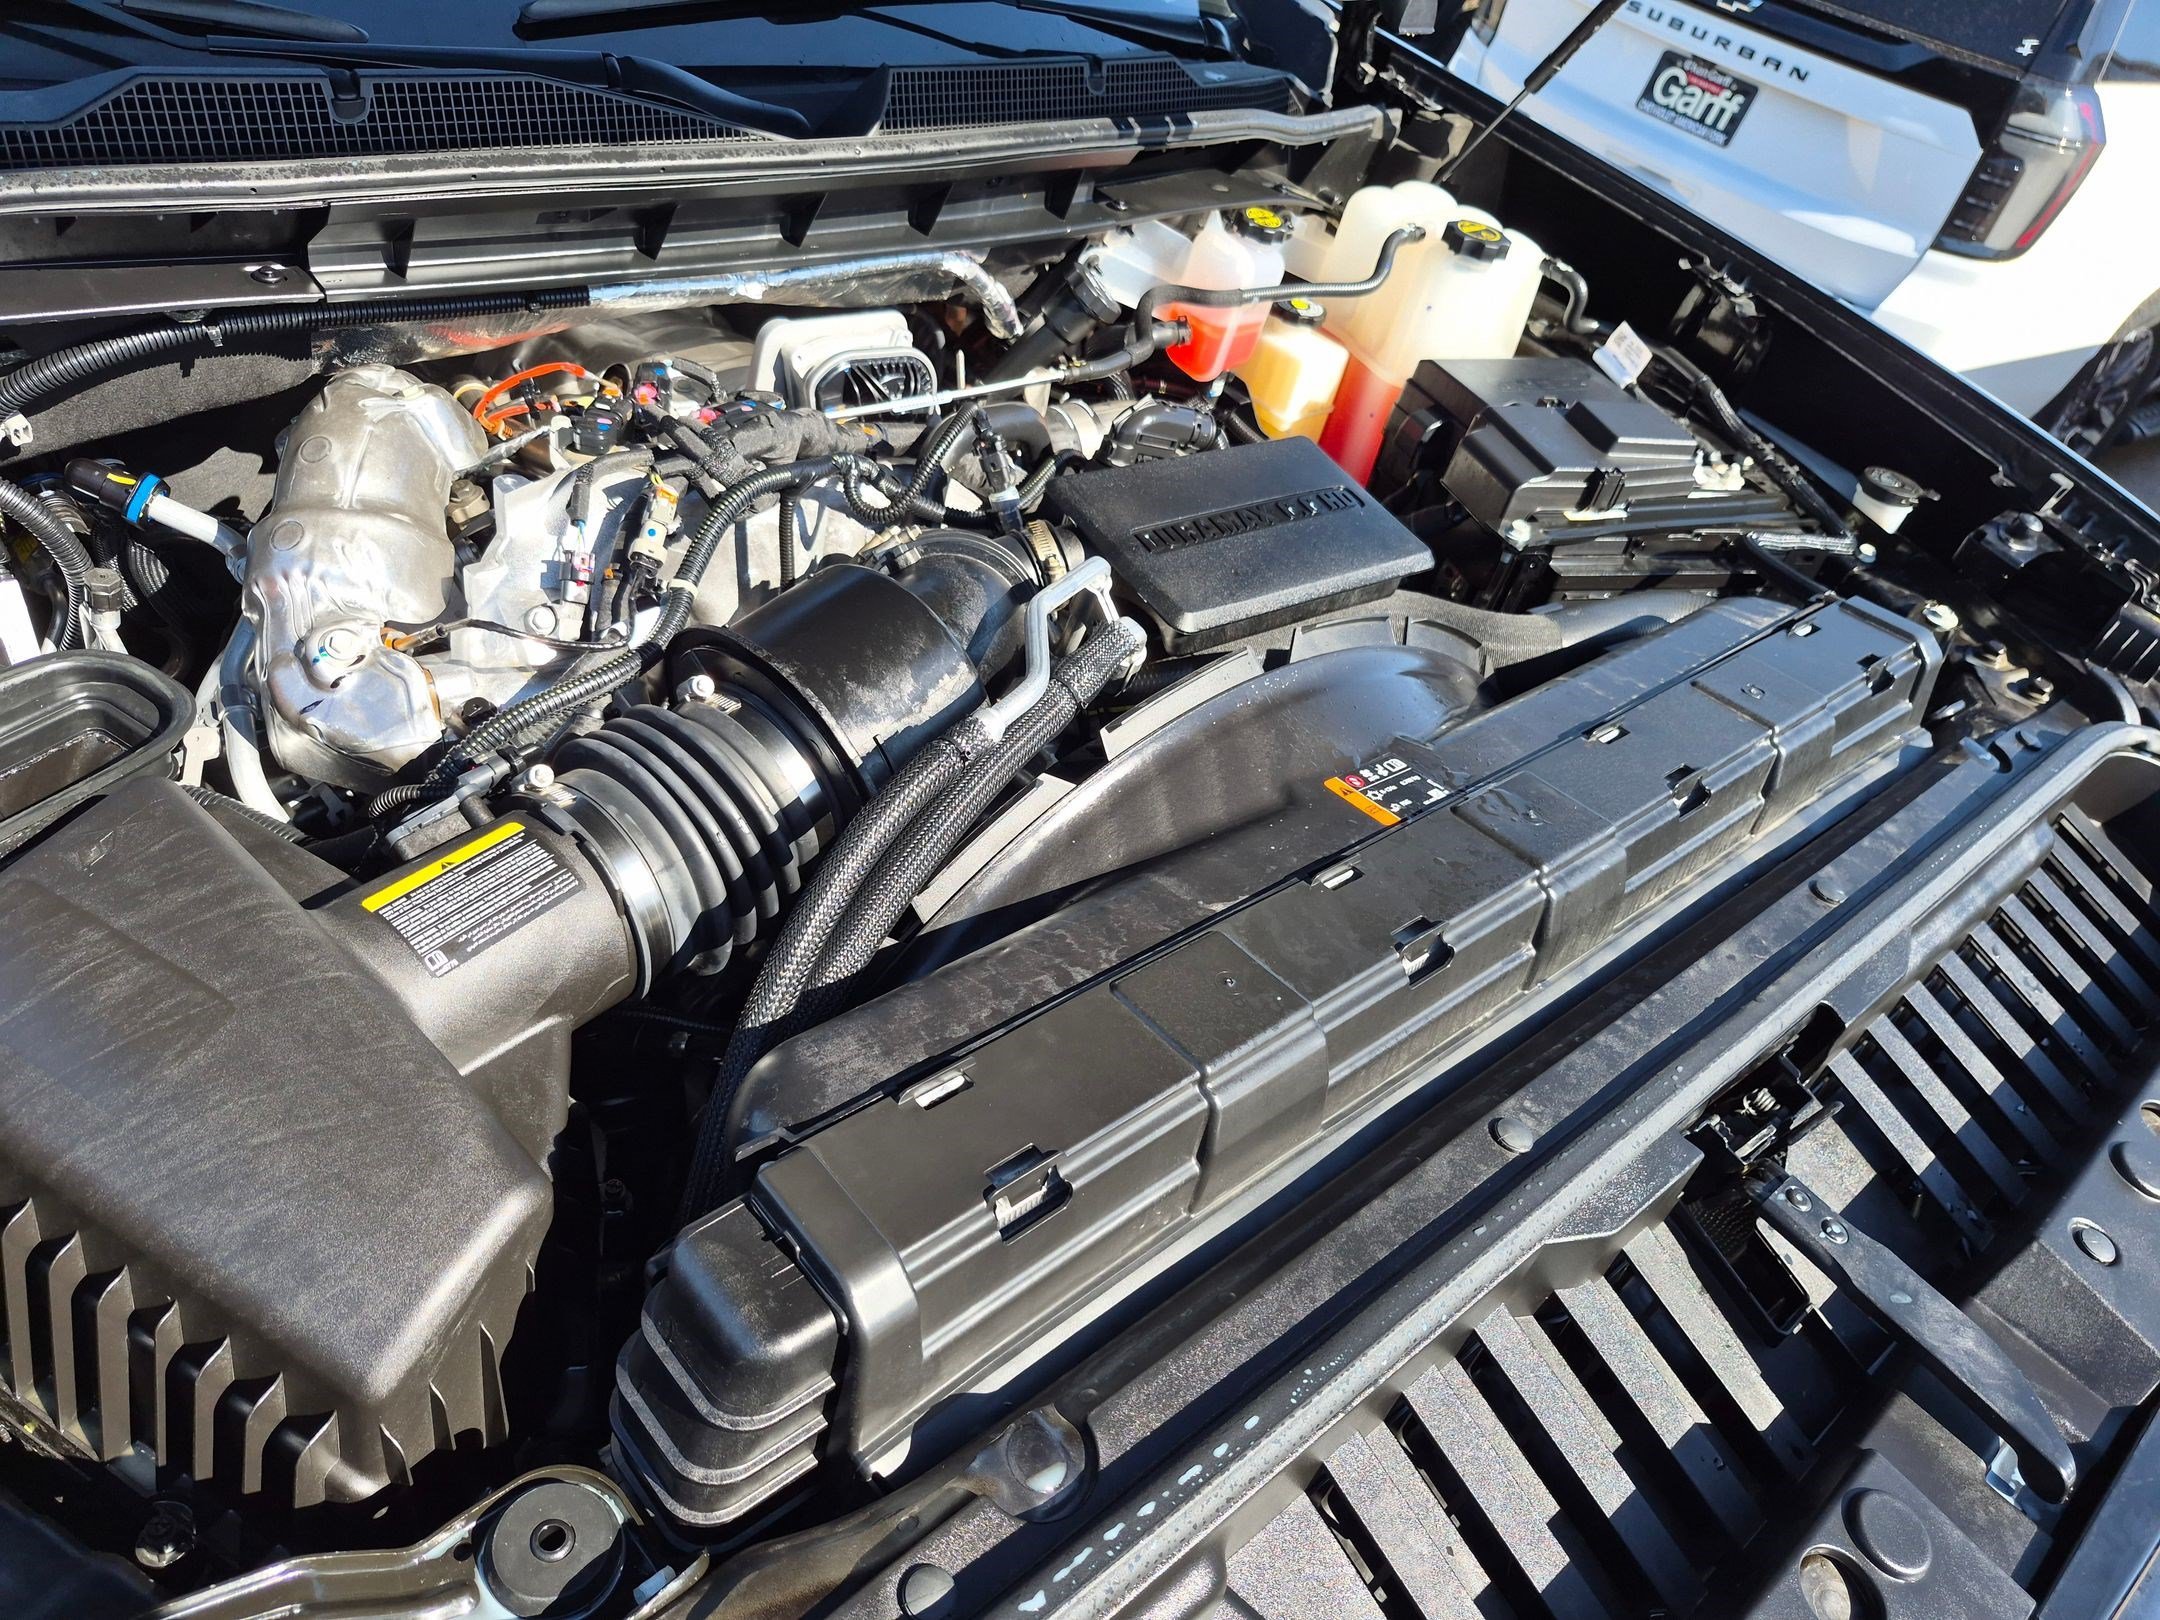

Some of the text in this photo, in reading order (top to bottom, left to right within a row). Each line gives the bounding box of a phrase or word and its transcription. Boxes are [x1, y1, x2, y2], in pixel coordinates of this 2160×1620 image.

[1625, 0, 1810, 81] SUBURBAN
[1652, 65, 1746, 132] Garff
[1134, 504, 1275, 553] DURAMAX
